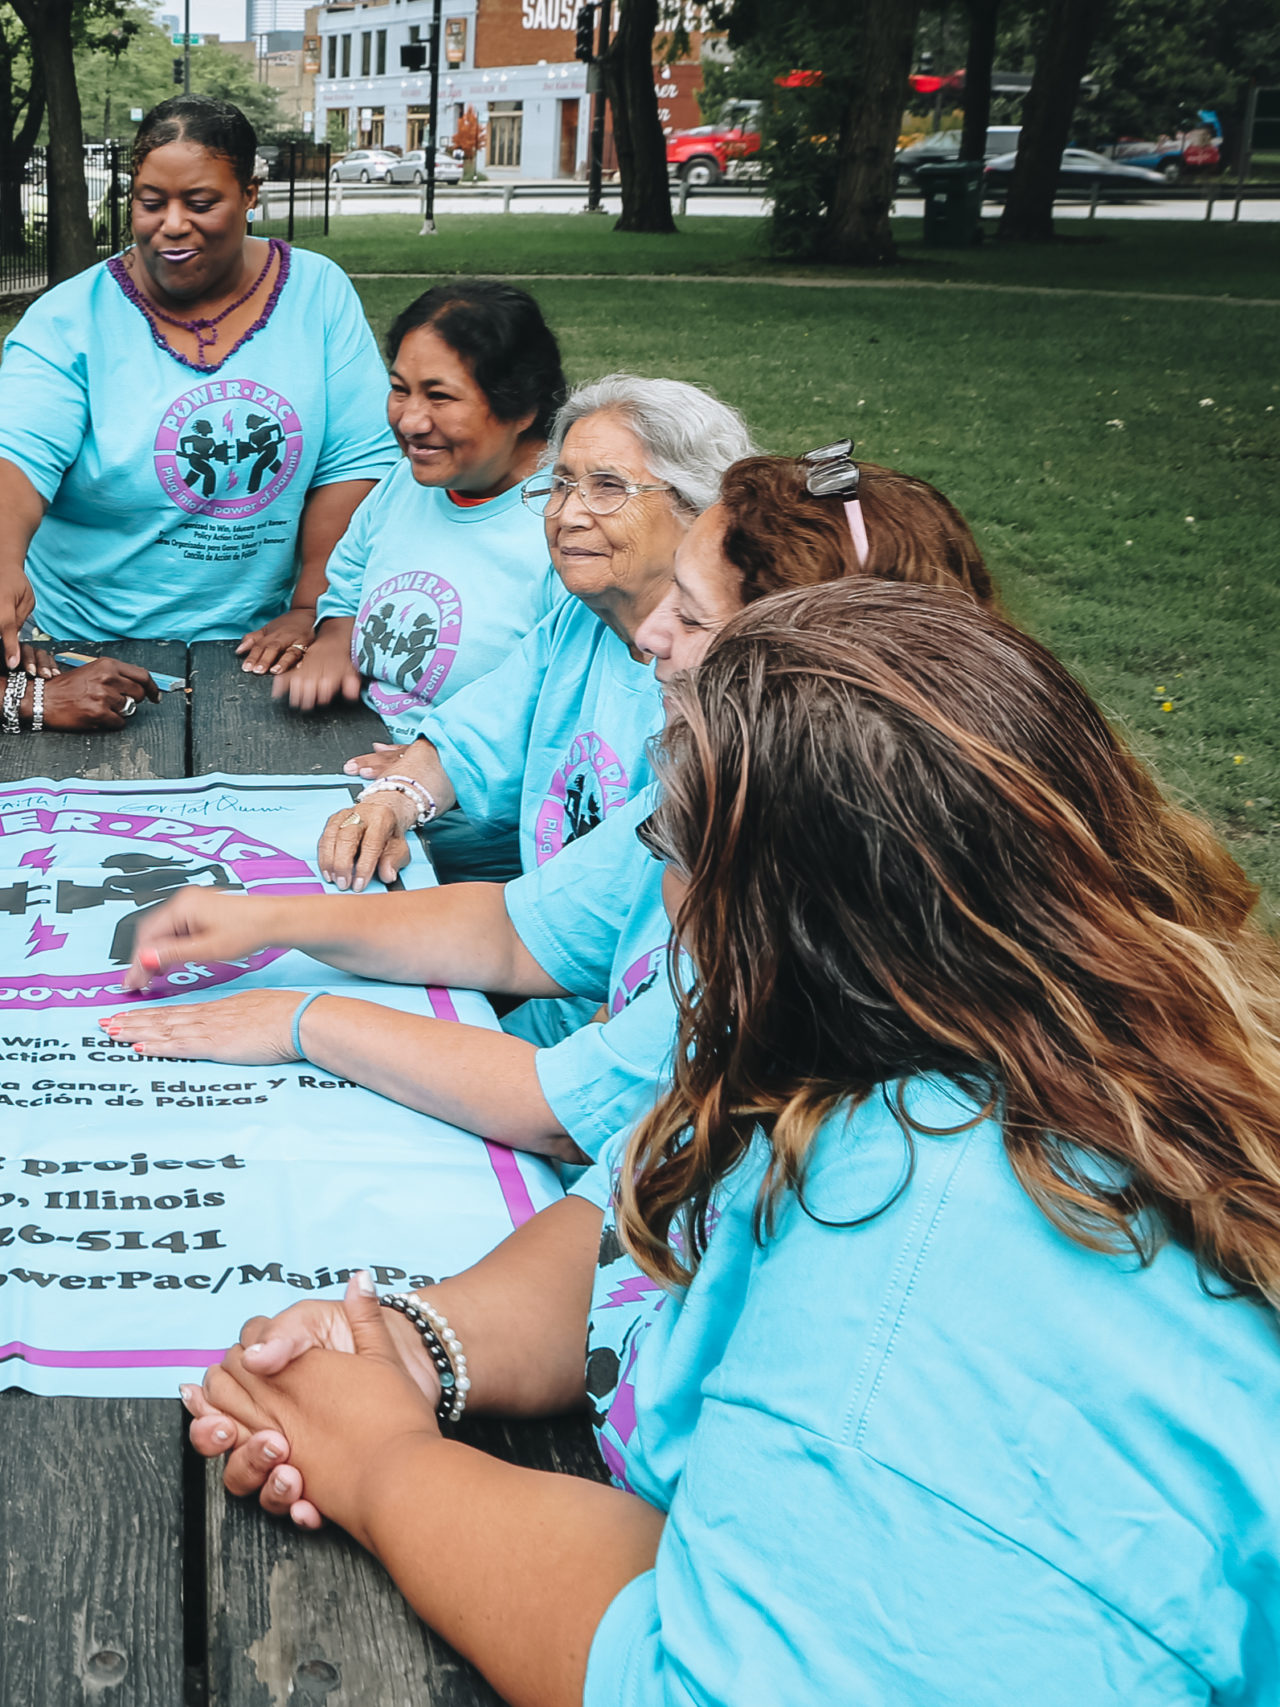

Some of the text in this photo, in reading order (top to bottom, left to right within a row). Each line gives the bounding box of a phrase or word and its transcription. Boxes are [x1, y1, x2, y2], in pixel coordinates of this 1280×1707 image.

[213, 502, 257, 515] power
[259, 491, 271, 505] of
[271, 449, 299, 494] parents
[541, 818, 558, 854] Plug
[167, 961, 216, 985] of
[2, 1037, 71, 1048] Win,
[31, 1079, 139, 1093] Ganar,
[151, 1080, 258, 1092] Educar
[267, 1077, 288, 1089] y
[104, 1096, 144, 1107] de
[156, 1093, 269, 1107] Pólizas
[21, 1153, 246, 1177] project
[44, 1188, 226, 1210] Illinois
